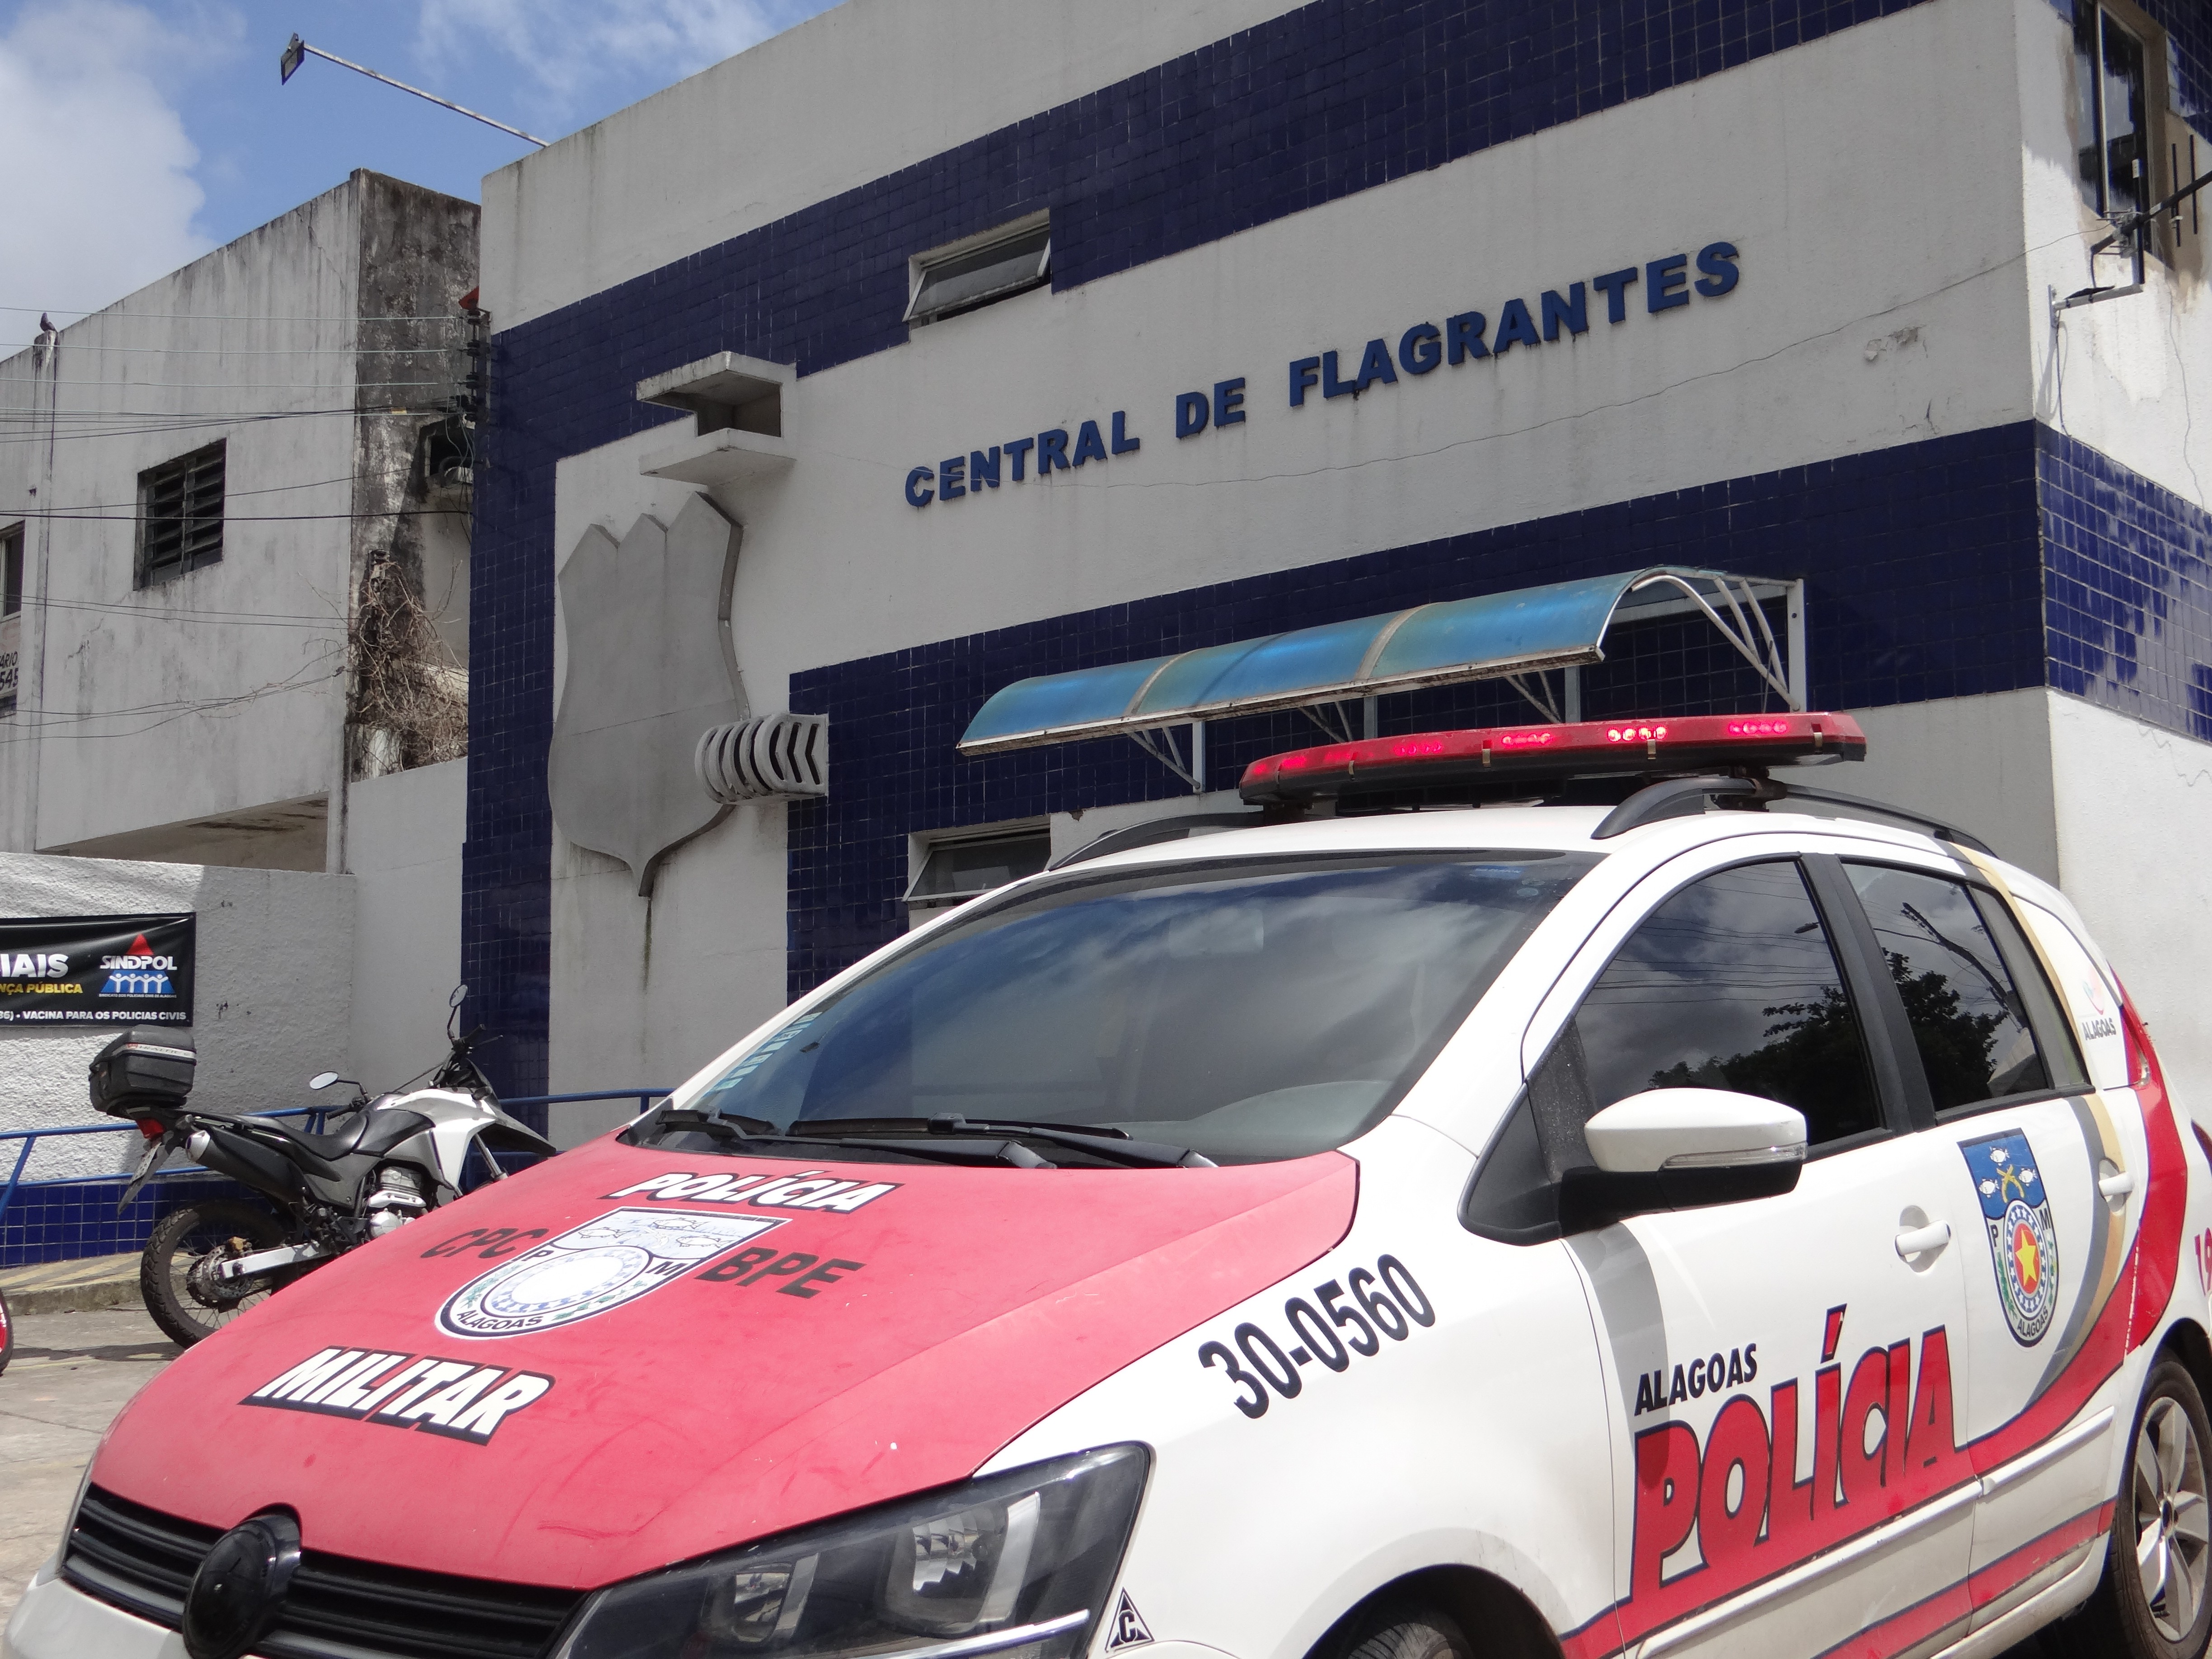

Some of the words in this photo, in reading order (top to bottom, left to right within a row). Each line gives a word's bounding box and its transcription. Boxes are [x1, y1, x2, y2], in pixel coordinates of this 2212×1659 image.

[905, 410, 1140, 507] CENTRAL
[1176, 377, 1246, 439] DE
[1289, 241, 1739, 407] FLAGRANTES
[0, 651, 18, 669] ÁRIO
[0, 954, 69, 978] IAIS
[100, 955, 178, 970] SINDPOL
[26, 981, 83, 994] PÚBLICA
[23, 1011, 64, 1020] VACINA
[66, 1011, 94, 1020] PARA
[95, 1011, 110, 1020] OS
[112, 1011, 157, 1020] POLICIAS
[159, 1012, 187, 1020] CIVIS
[2082, 1017, 2117, 1041] ALAGOAS
[598, 1170, 905, 1214] POLÍCIA
[420, 1228, 550, 1259] CPC
[1989, 1224, 1999, 1247] P
[2039, 1208, 2051, 1231] M
[521, 1249, 555, 1261] P
[645, 1260, 689, 1276] M
[694, 1247, 867, 1298] BPE
[456, 1310, 544, 1330] ALAGOAS
[2016, 1305, 2048, 1337] ALAGOAS
[1198, 1254, 1436, 1419] 30-0560
[238, 1345, 556, 1446] MILITAR
[1634, 1343, 1757, 1416] ALAGOAS
[1631, 1303, 1958, 1602] POLÍCIA
[1118, 1610, 1137, 1643] C
